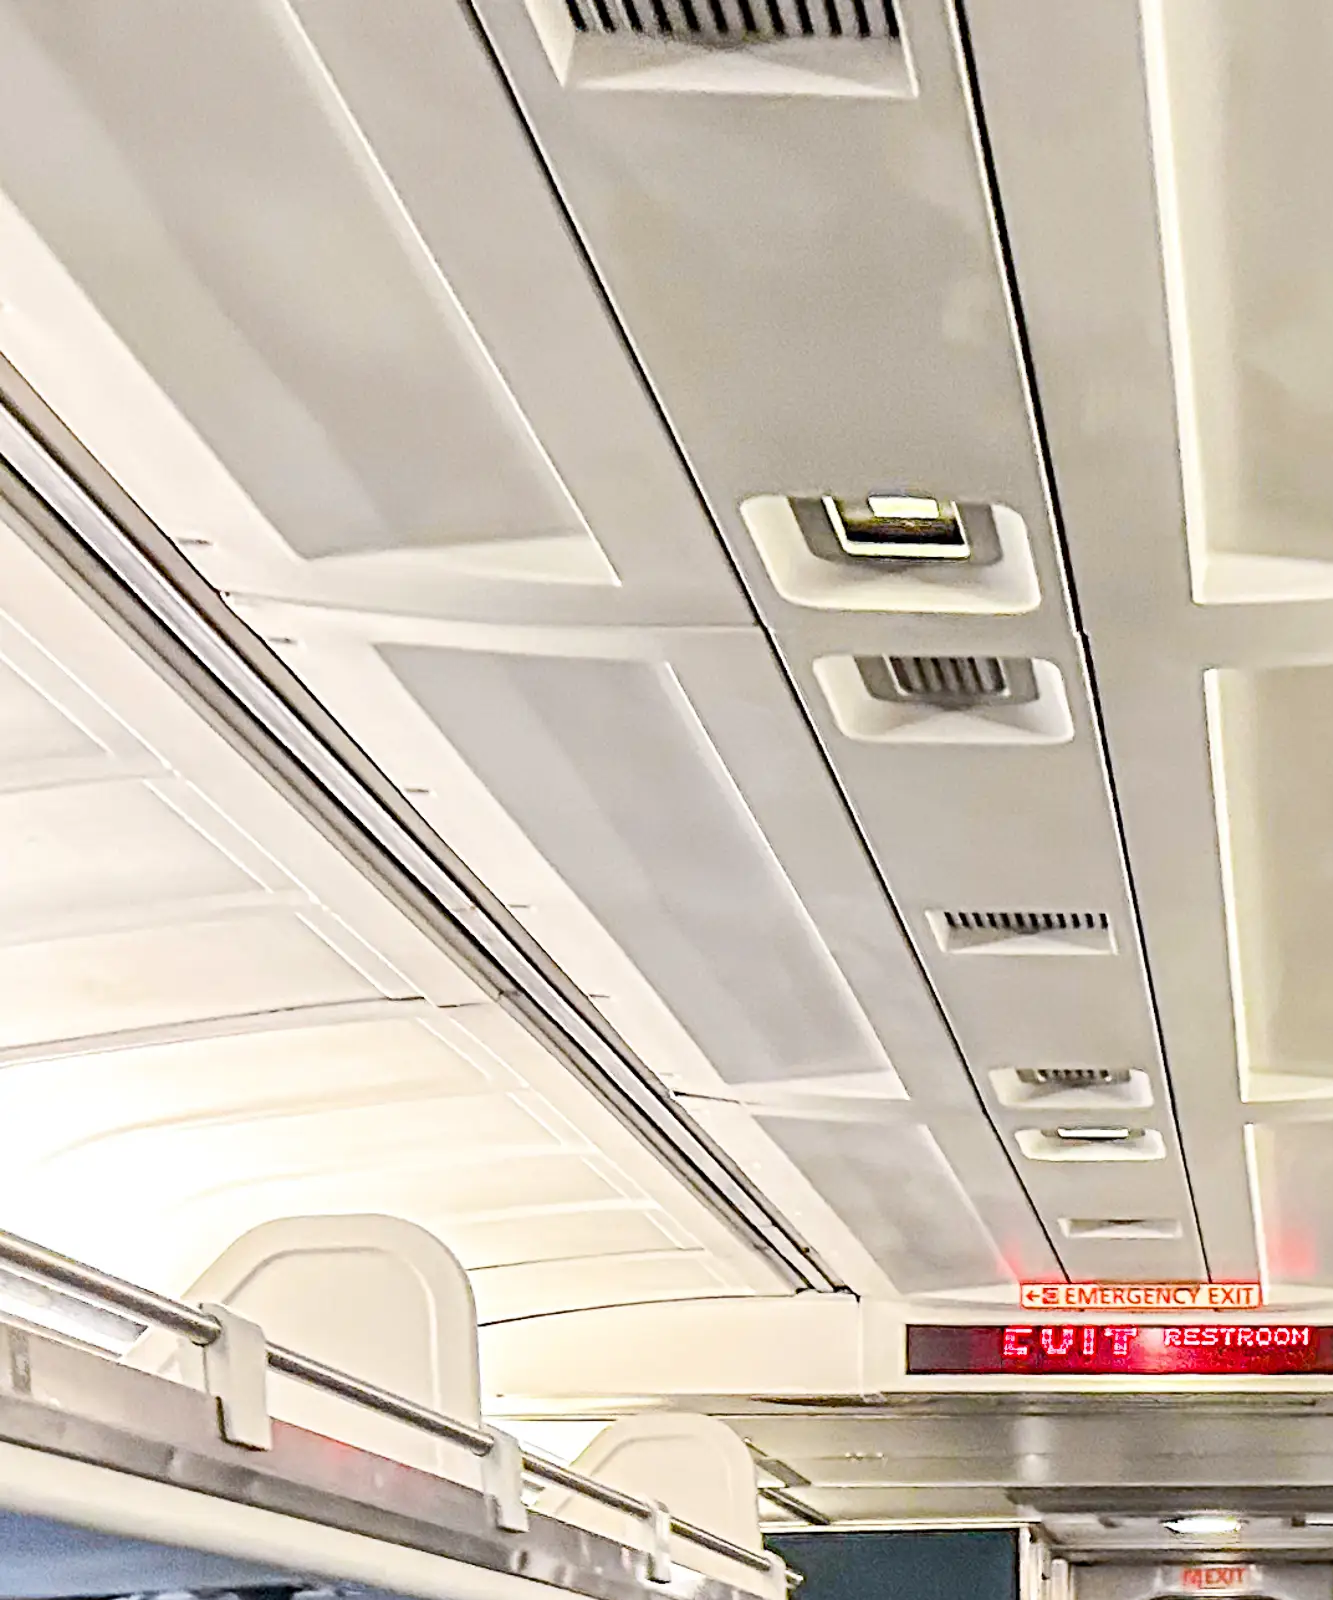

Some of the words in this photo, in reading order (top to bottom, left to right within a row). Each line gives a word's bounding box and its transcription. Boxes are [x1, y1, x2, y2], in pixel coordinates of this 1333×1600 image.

[1065, 1287, 1200, 1305] EMERGENCY
[1208, 1287, 1255, 1305] EXIT
[1163, 1327, 1310, 1345] RESTROOM
[1205, 1568, 1245, 1584] EXIT
